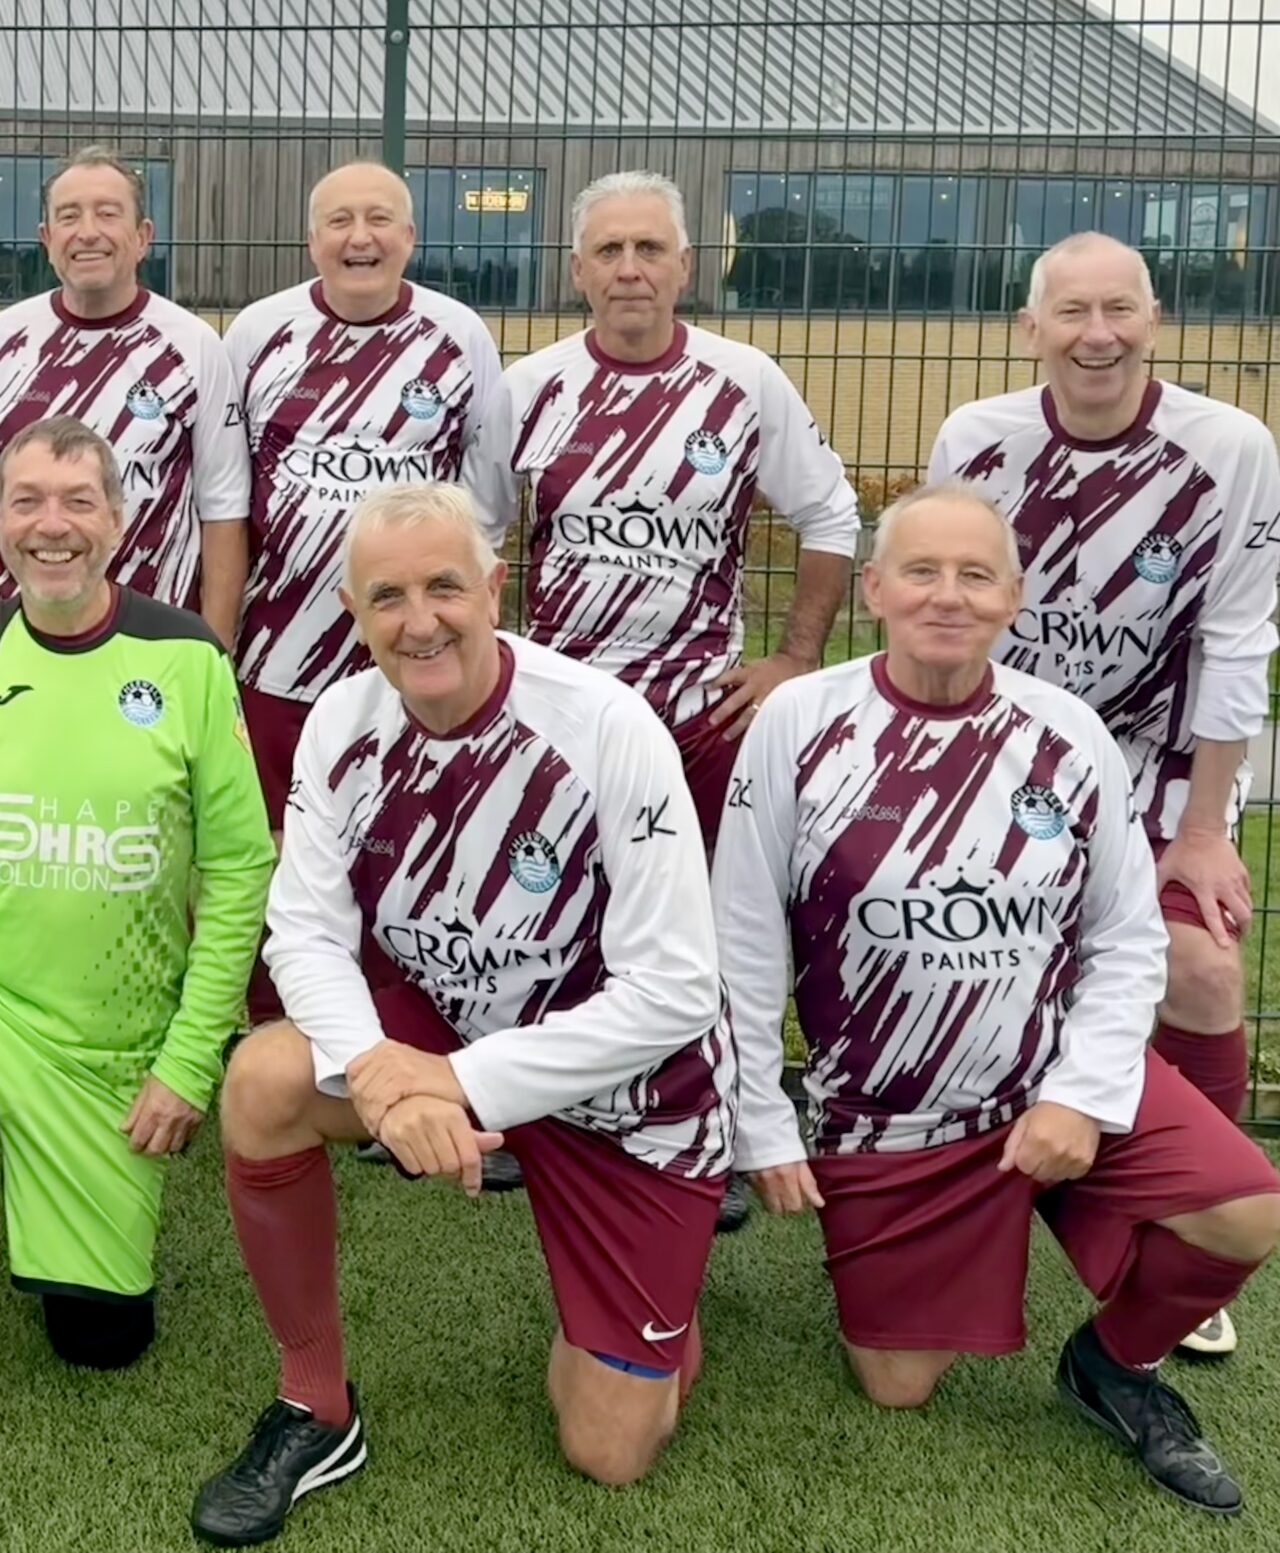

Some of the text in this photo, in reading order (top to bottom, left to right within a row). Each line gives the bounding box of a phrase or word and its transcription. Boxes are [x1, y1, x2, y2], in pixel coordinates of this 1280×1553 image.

[284, 450, 427, 482] CROWN
[559, 514, 718, 550] CROWN
[858, 896, 1063, 942] CROWN
[922, 949, 1020, 970] PAINTS
